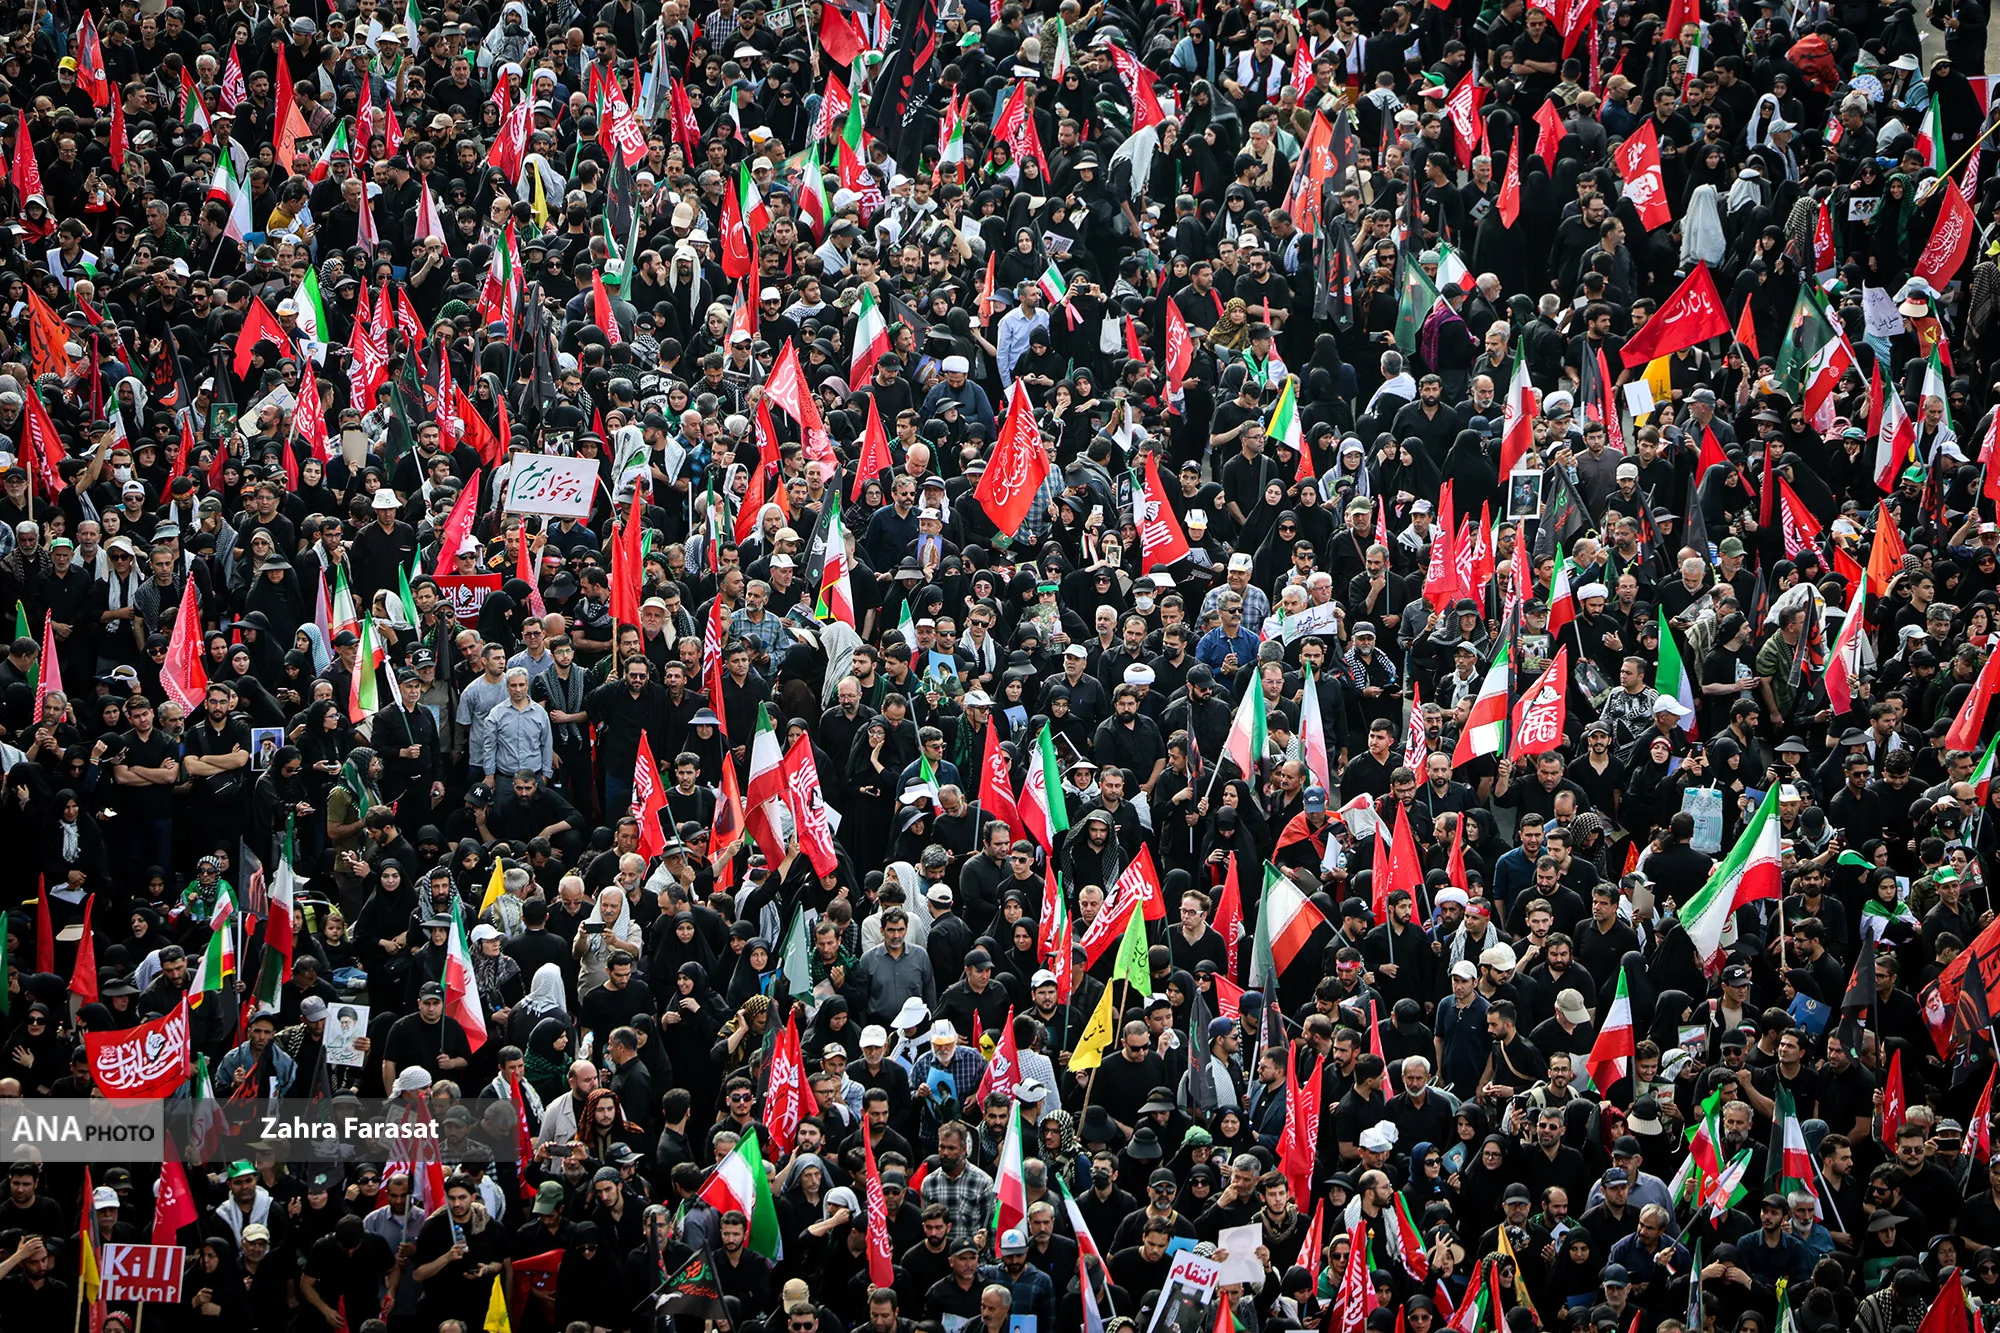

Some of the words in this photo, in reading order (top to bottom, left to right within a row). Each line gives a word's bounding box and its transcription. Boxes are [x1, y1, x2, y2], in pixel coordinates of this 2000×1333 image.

[574, 490, 582, 503] ما
[104, 1245, 174, 1281] Kill
[1170, 1261, 1219, 1288] انتقام
